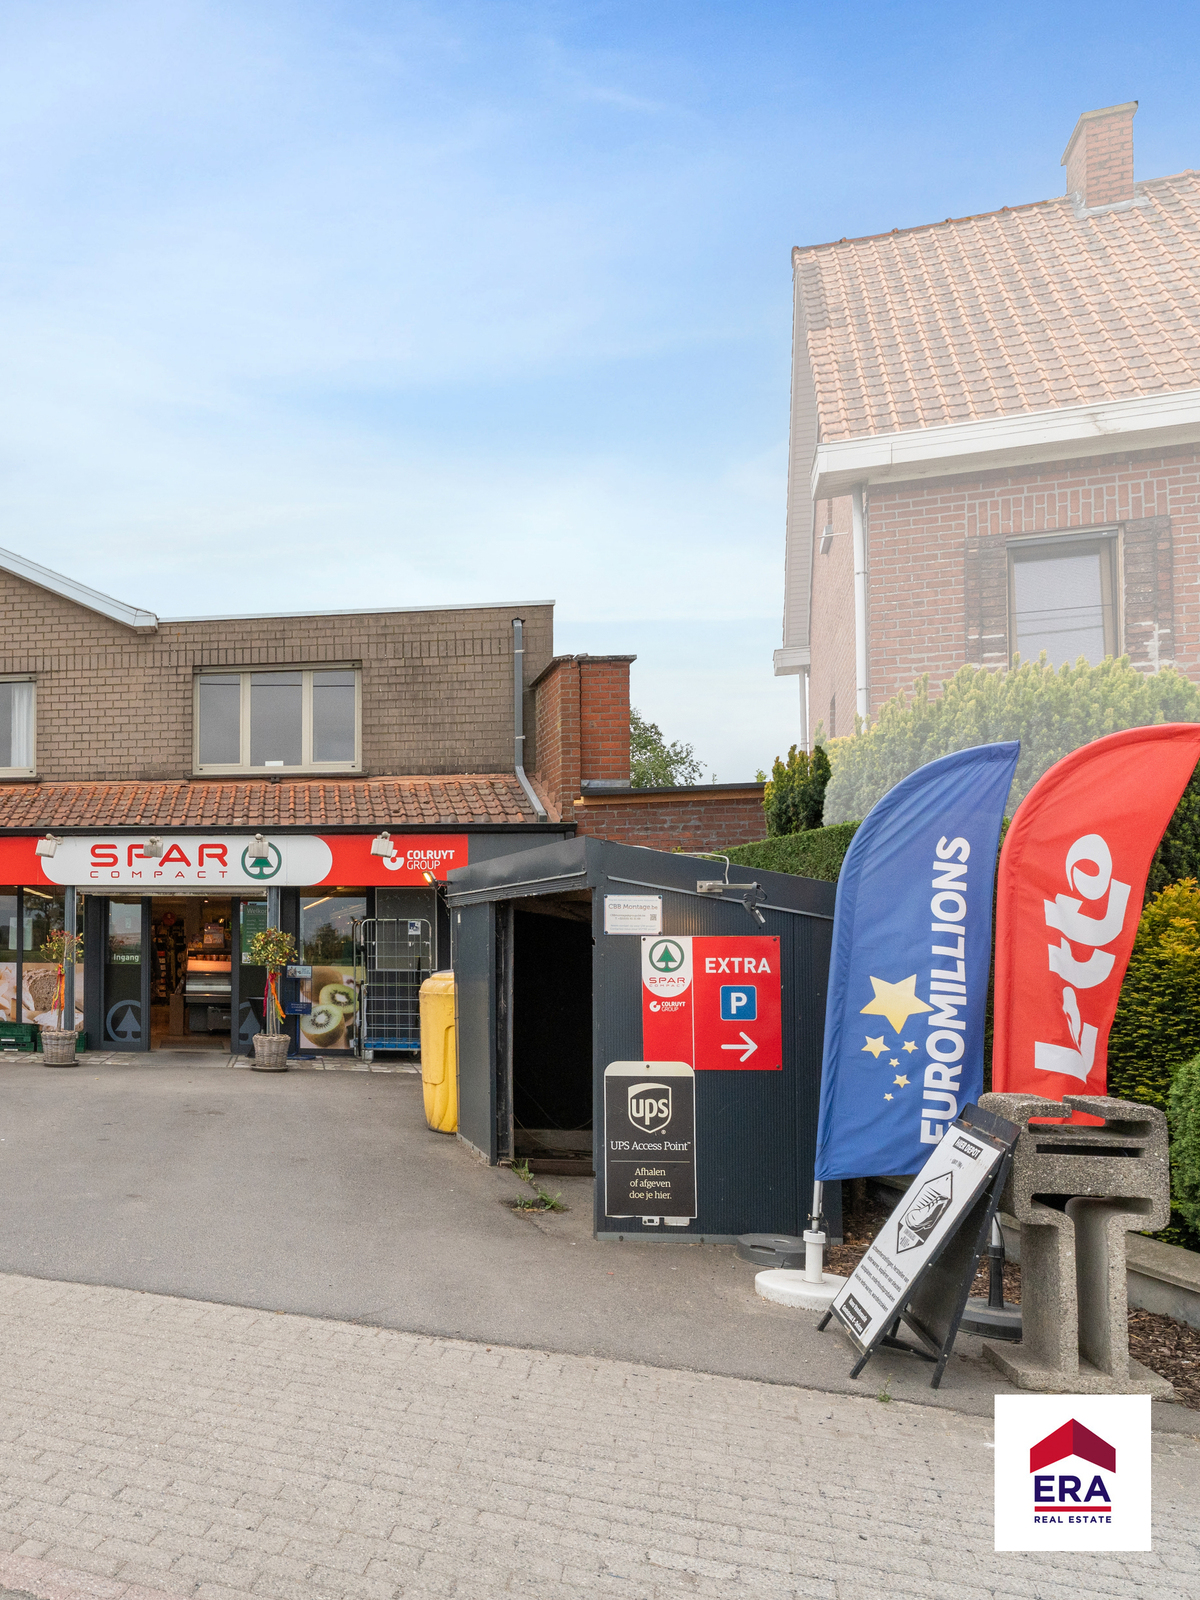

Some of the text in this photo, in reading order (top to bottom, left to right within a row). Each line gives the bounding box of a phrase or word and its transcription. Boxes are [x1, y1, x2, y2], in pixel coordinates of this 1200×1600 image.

[90, 844, 228, 867] SPAR
[407, 850, 455, 859] COLRUYT
[407, 860, 440, 870] GROUP
[114, 954, 139, 962] Ingang
[705, 958, 771, 973] EXTRA
[920, 835, 971, 1145] EUROMILLIONS
[731, 992, 748, 1014] P
[631, 1099, 669, 1125] ups
[610, 1141, 630, 1150] UPS
[631, 1141, 662, 1150] Access
[954, 1138, 981, 1158] HIER DEPOT
[635, 1168, 666, 1176] Afhalen
[630, 1179, 671, 1189] of afgeven
[646, 1191, 653, 1200] je
[655, 1191, 672, 1199] hier.
